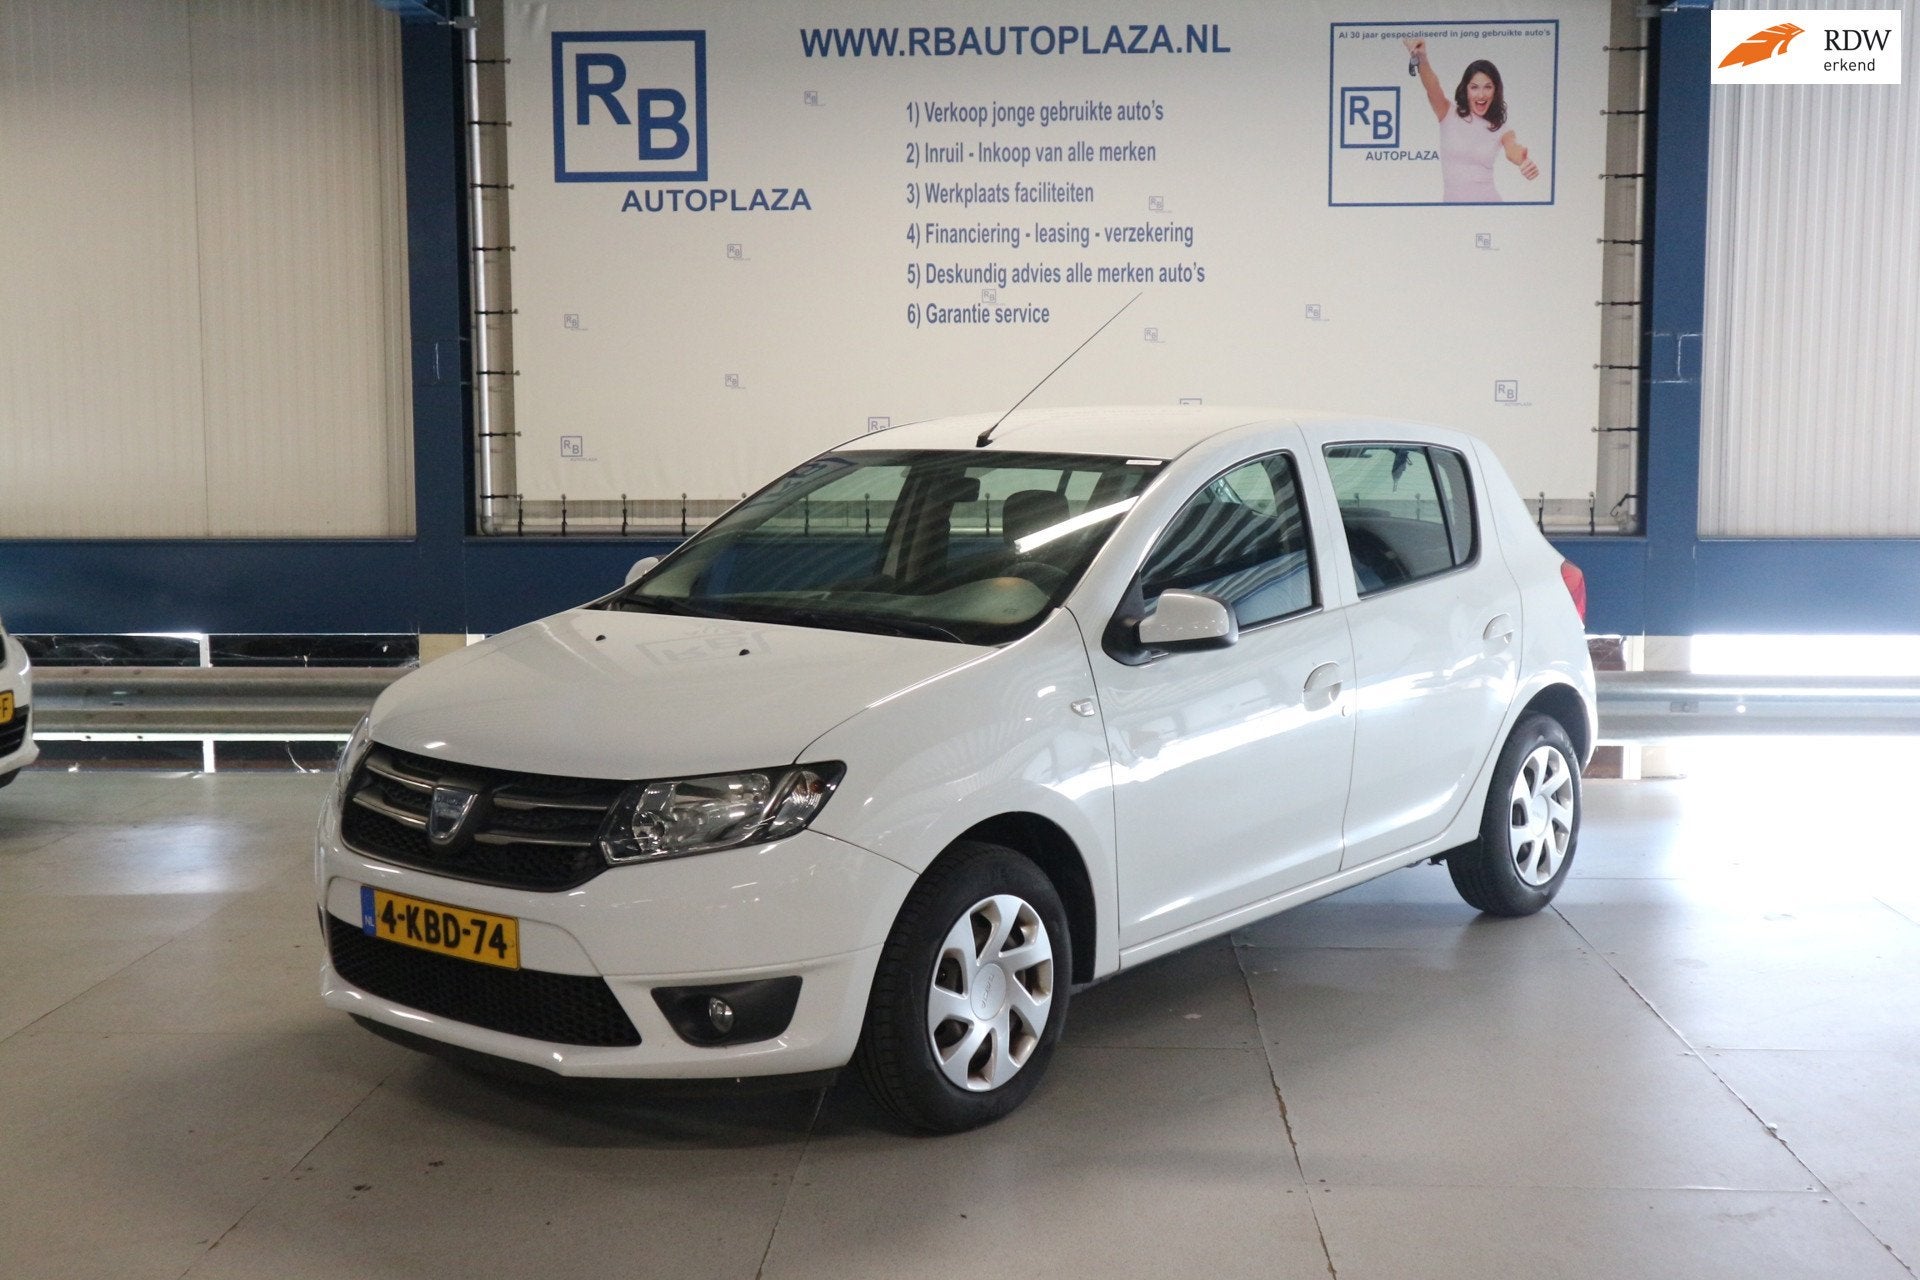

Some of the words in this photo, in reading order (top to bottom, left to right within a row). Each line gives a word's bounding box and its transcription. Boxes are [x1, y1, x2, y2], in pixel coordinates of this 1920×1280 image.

[800, 24, 1231, 57] WWW.RBAUTOPLAZA.NL
[1351, 31, 1360, 39] 30
[1362, 31, 1379, 40] jaar
[1381, 30, 1448, 39] gespecialiseerd
[1450, 30, 1458, 38] in
[1460, 30, 1479, 38] jong
[1482, 29, 1522, 38] gebruikte
[575, 53, 690, 160] RB
[906, 102, 920, 128] 1)
[924, 102, 988, 127] Verkoop
[992, 101, 1035, 127] jonge
[1039, 100, 1112, 127] gebruikte
[1350, 95, 1393, 140] RB
[906, 142, 920, 168] 2)
[925, 142, 963, 163] Inruil
[978, 142, 1030, 167] Inkoop
[1035, 147, 1062, 163] van
[1068, 141, 1094, 162] alle
[1099, 141, 1156, 162] merken
[1365, 151, 1439, 161] AUTOPLAZA
[621, 188, 812, 212] AUTOPLAZA
[906, 183, 920, 209] 3)
[925, 182, 1009, 208] Werkplaats
[1014, 182, 1094, 203] faciliteiten
[906, 223, 921, 249] 4)
[925, 223, 1020, 248] Financiering
[1035, 222, 1090, 248] leasing
[1104, 222, 1194, 247] verzekering
[907, 263, 921, 289] 5)
[926, 263, 1006, 288] Deskundig
[1012, 262, 1062, 283] advies
[1066, 262, 1093, 283] alle
[1097, 262, 1154, 283] merken
[908, 303, 921, 329] 6)
[926, 302, 990, 324] Garantie
[994, 303, 1050, 324] service
[365, 915, 375, 927] NL
[381, 900, 507, 959] 4-KBD-74
